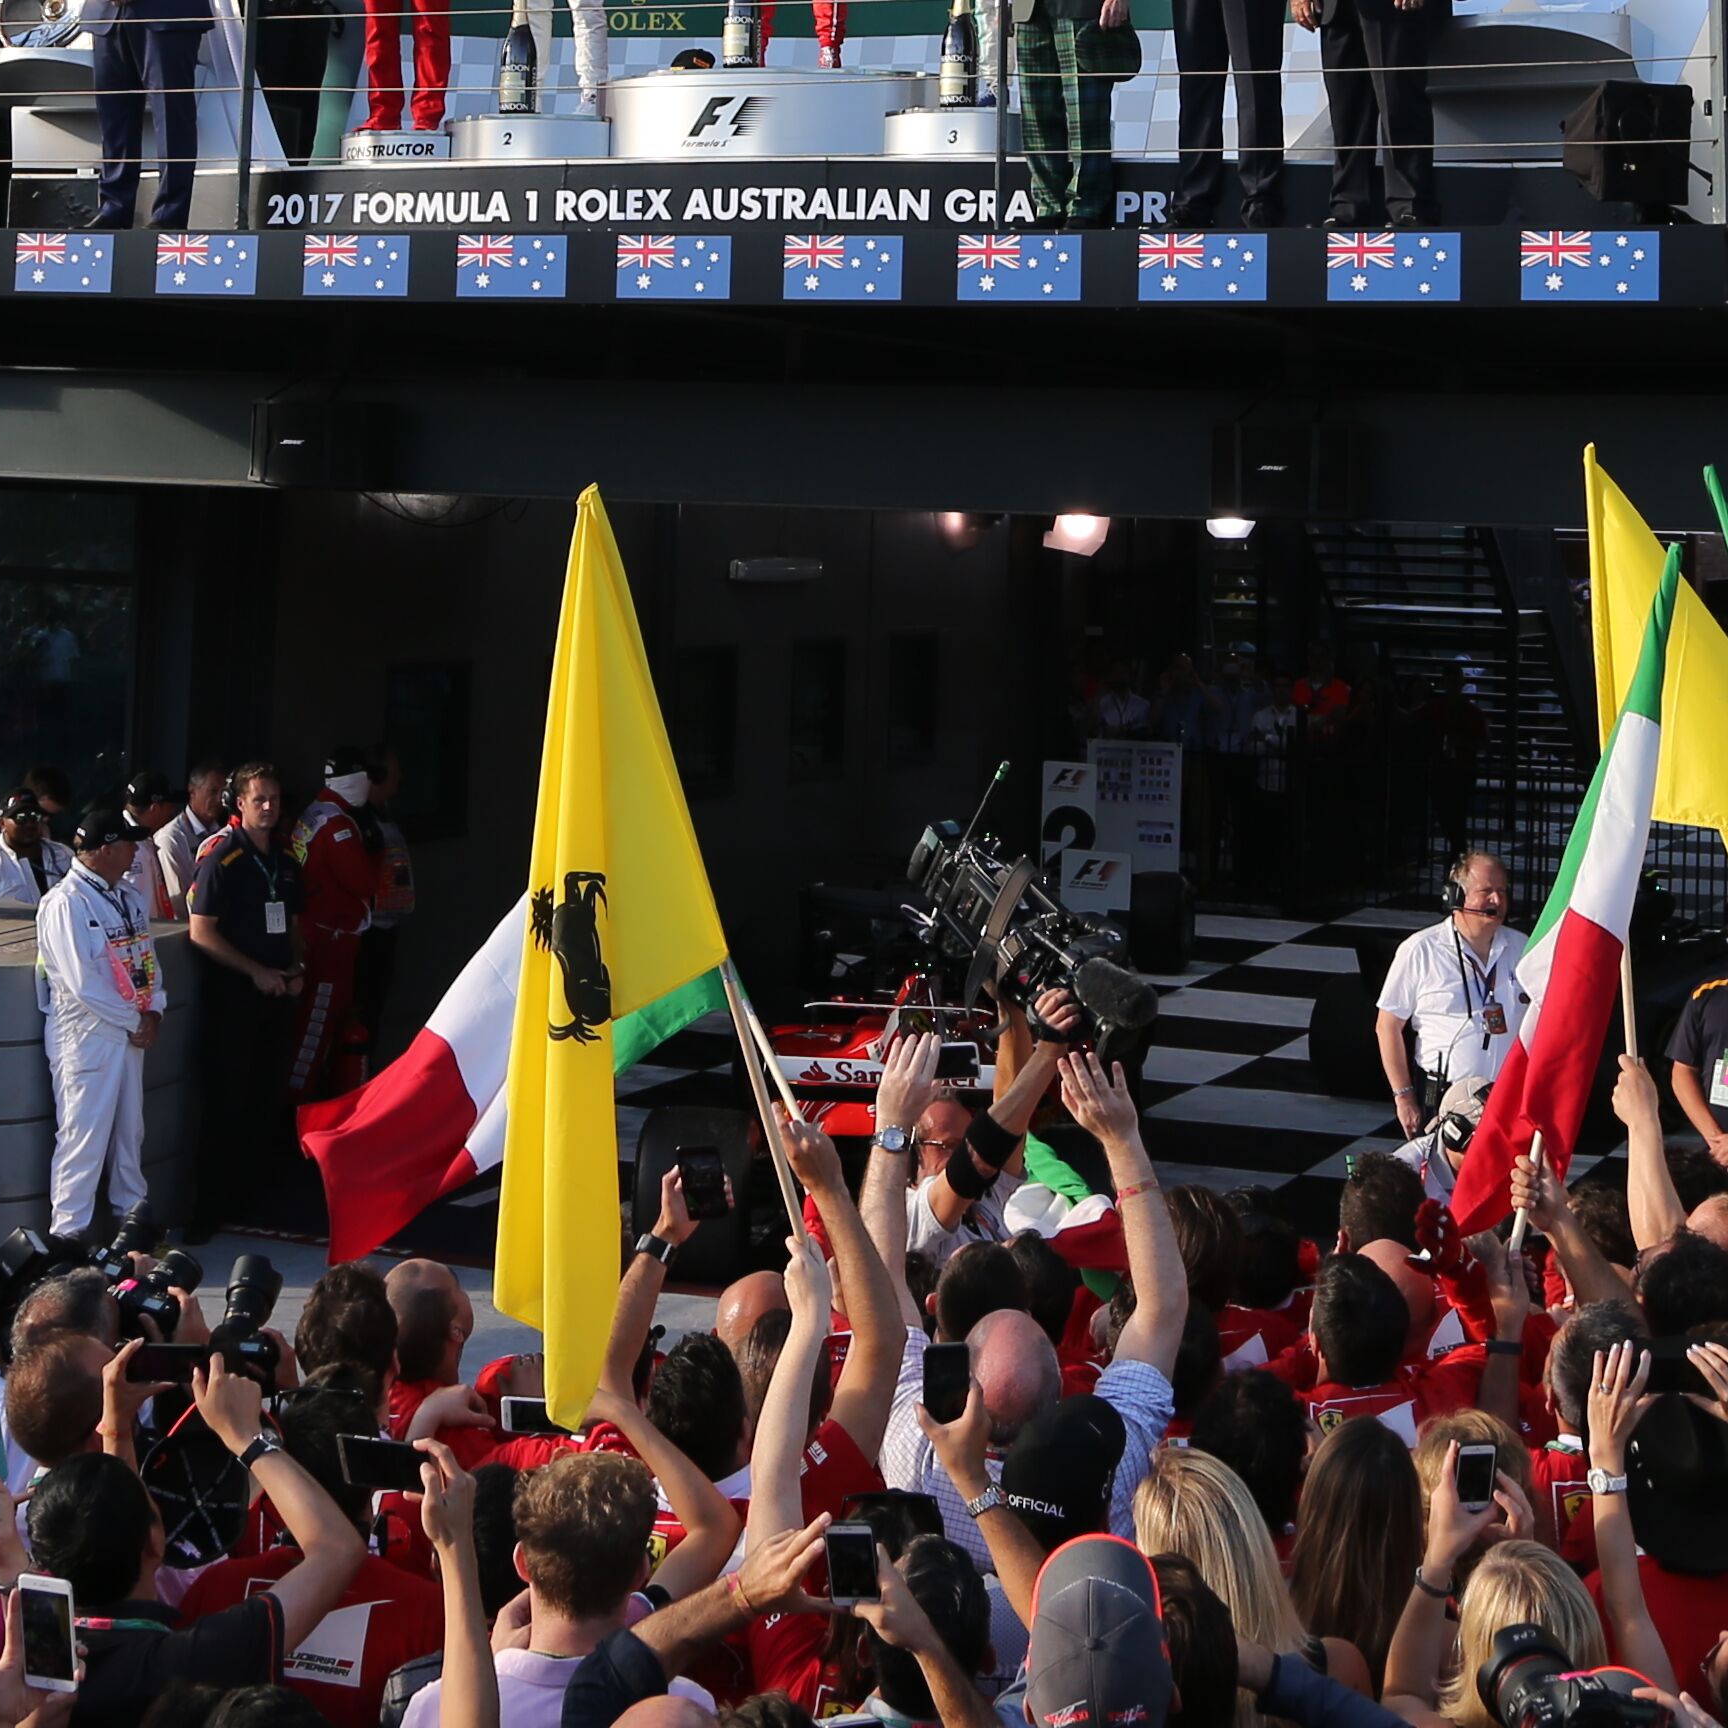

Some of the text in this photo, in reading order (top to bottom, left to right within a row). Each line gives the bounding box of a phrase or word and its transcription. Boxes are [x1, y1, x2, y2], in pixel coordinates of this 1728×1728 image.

[606, 12, 686, 31] OLEX
[504, 132, 513, 145] 2
[947, 130, 958, 143] 3
[345, 141, 435, 159] CONSTRUCTOR
[268, 185, 1169, 225] 2017 FORMULA 1 ROLEX AUSTRALIAN GRA PRI
[834, 1061, 976, 1088] Saner
[1008, 1494, 1065, 1518] OFFICIAL
